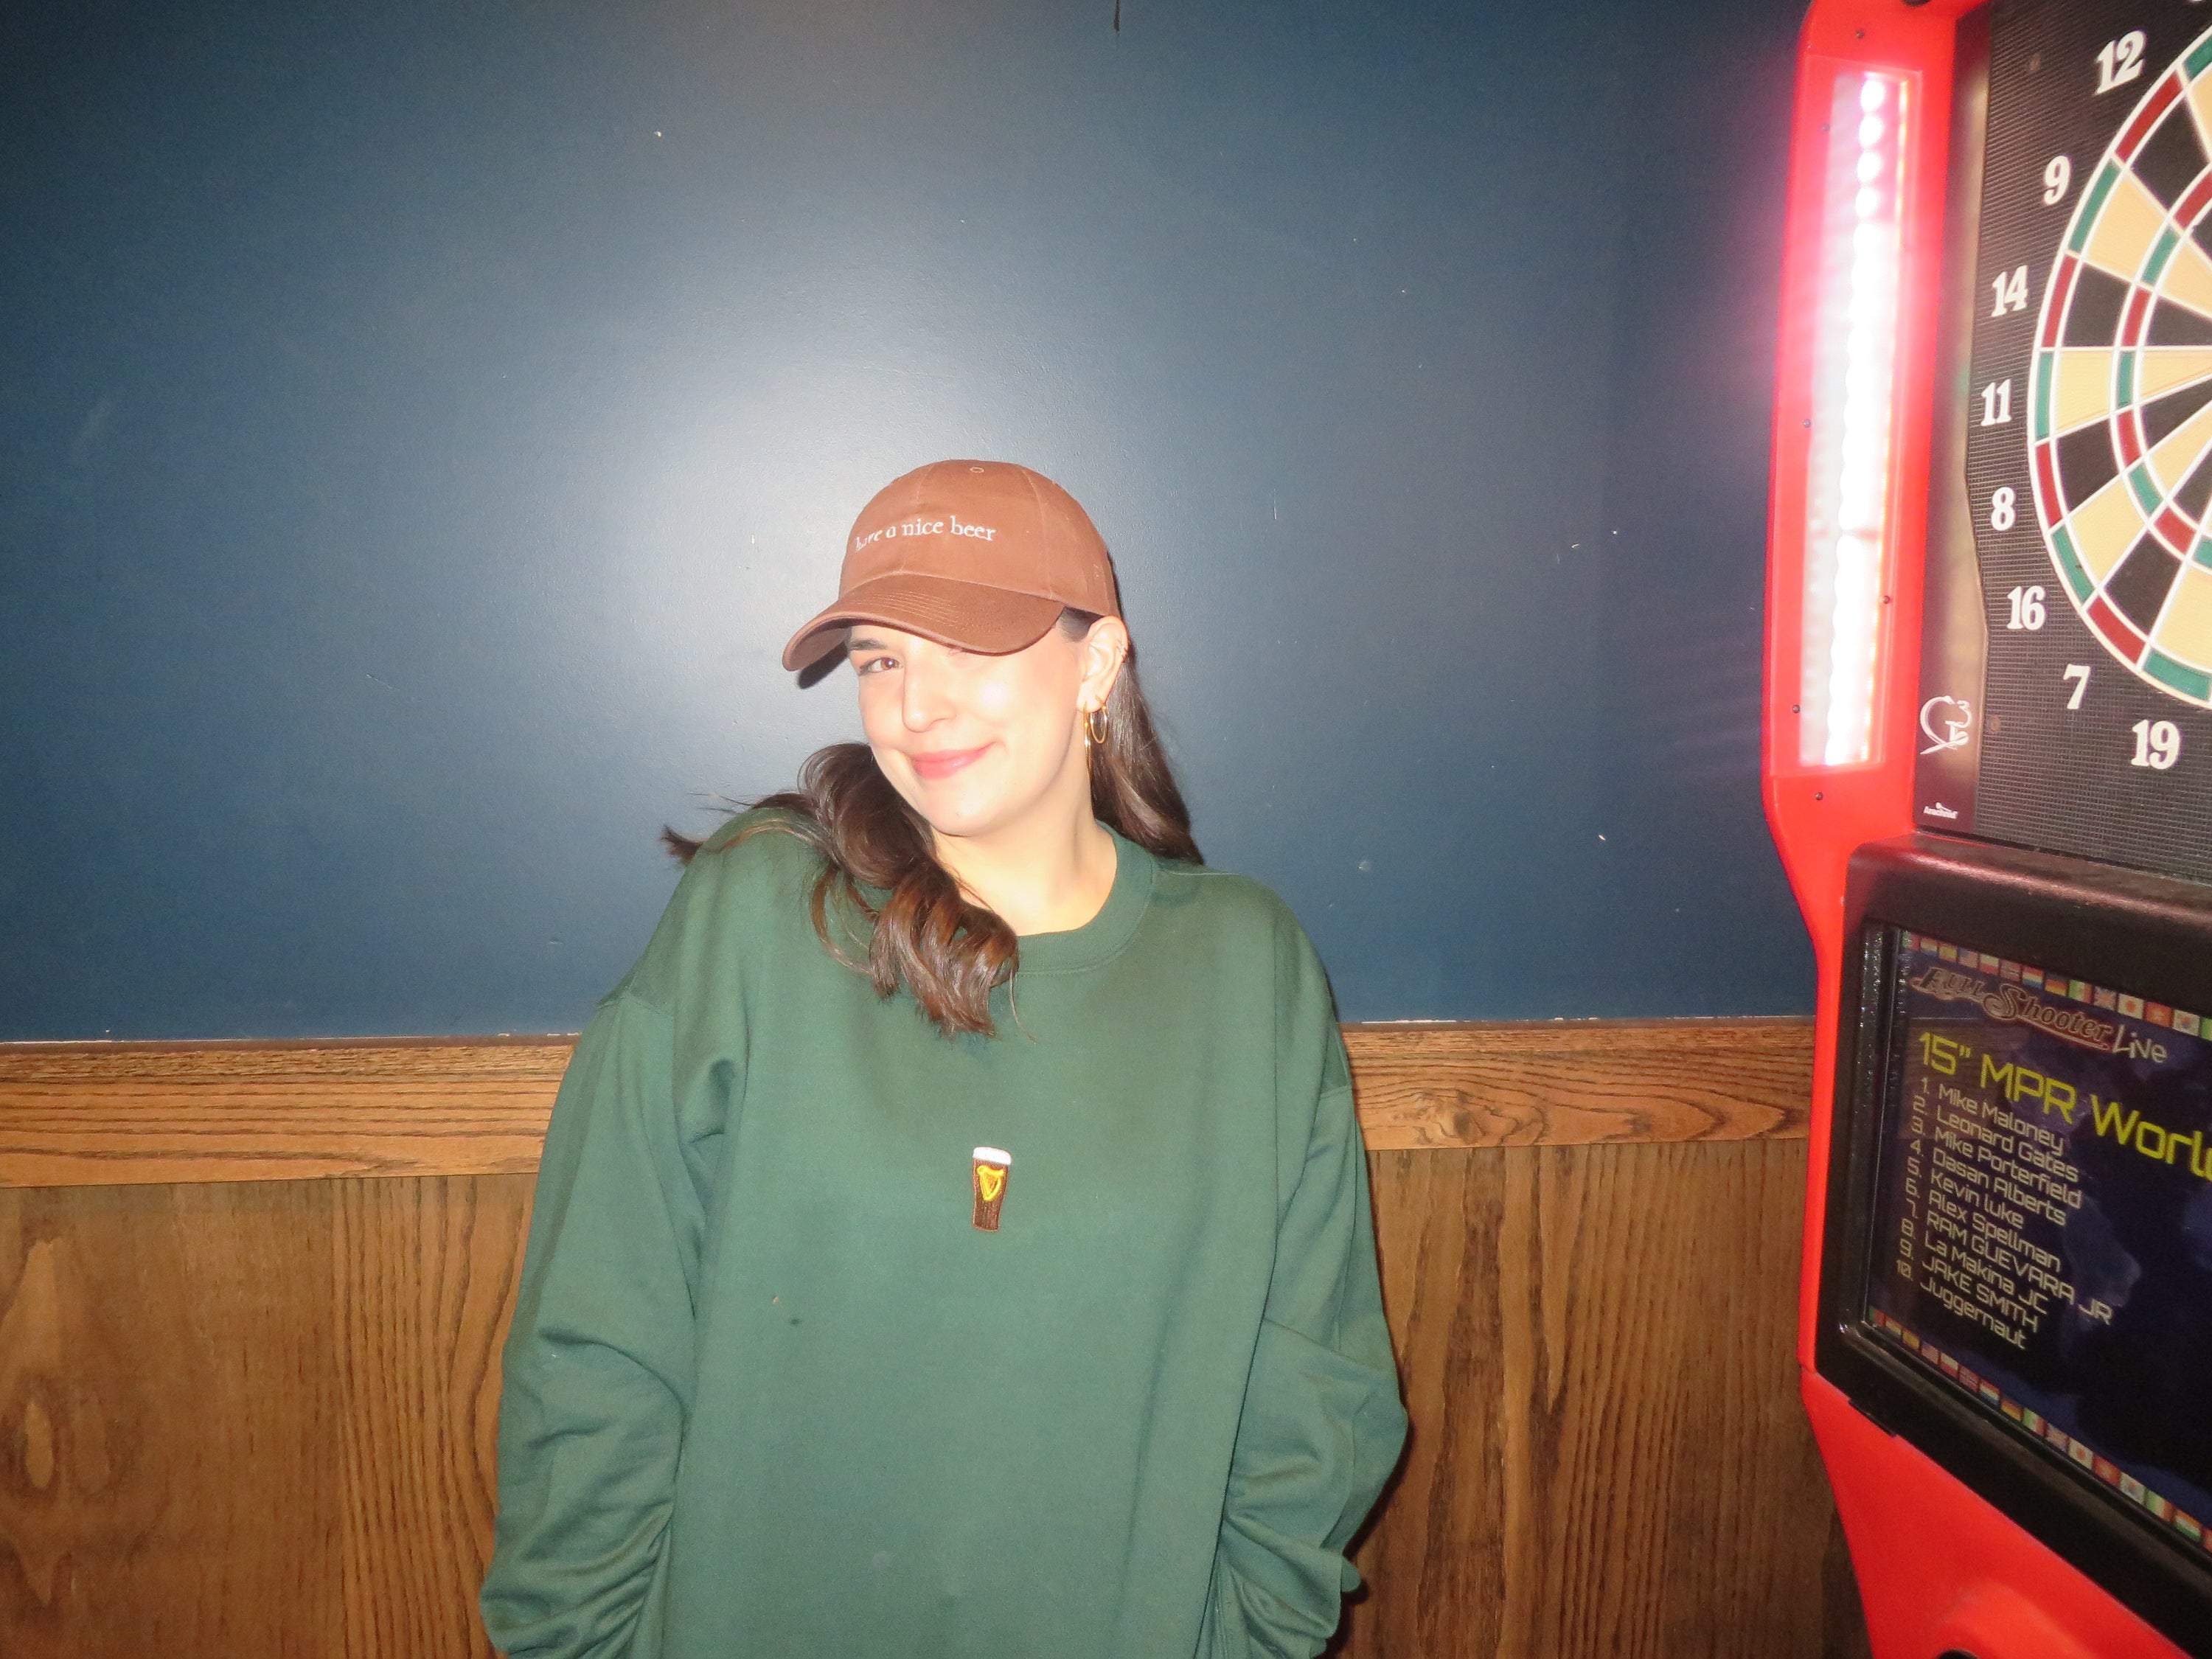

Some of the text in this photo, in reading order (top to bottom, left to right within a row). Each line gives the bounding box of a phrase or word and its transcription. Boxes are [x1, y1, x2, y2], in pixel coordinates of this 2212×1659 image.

[2094, 30, 2147, 94] 12
[2043, 155, 2071, 205] 9
[1992, 265, 2028, 317] 14
[1980, 379, 2012, 426] 11
[855, 515, 996, 552] have a nice beer
[1991, 487, 2017, 531] 8
[2007, 585, 2046, 630] 16
[2063, 664, 2091, 710] 7
[2131, 720, 2181, 770] 19
[1980, 1054, 2076, 1124] MPR
[1937, 1105, 2014, 1153] Leonard
[2019, 1141, 2079, 1183] Gates
[1939, 1083, 1978, 1115] Mike
[1982, 1099, 2064, 1157] Maloney
[1930, 1168, 1980, 1207] Kevin
[1935, 1127, 1973, 1159] Mike
[1978, 1145, 2084, 1209] Porterfield
[1929, 1189, 1967, 1224] Alex
[1972, 1211, 2062, 1273] Spellman
[1994, 1178, 2067, 1226] Alberts
[1921, 1256, 1973, 1295] JAKE
[1976, 1282, 2039, 1333] SMITH
[1924, 1230, 1948, 1258] La
[1951, 1246, 2015, 1296] Makina
[2018, 1290, 2049, 1315] JC
[1927, 1209, 1968, 1246] RAM
[1971, 1234, 2076, 1306] GUEVARA
[2079, 1298, 2114, 1326] JR
[1920, 1276, 2026, 1350] Juggernaut
